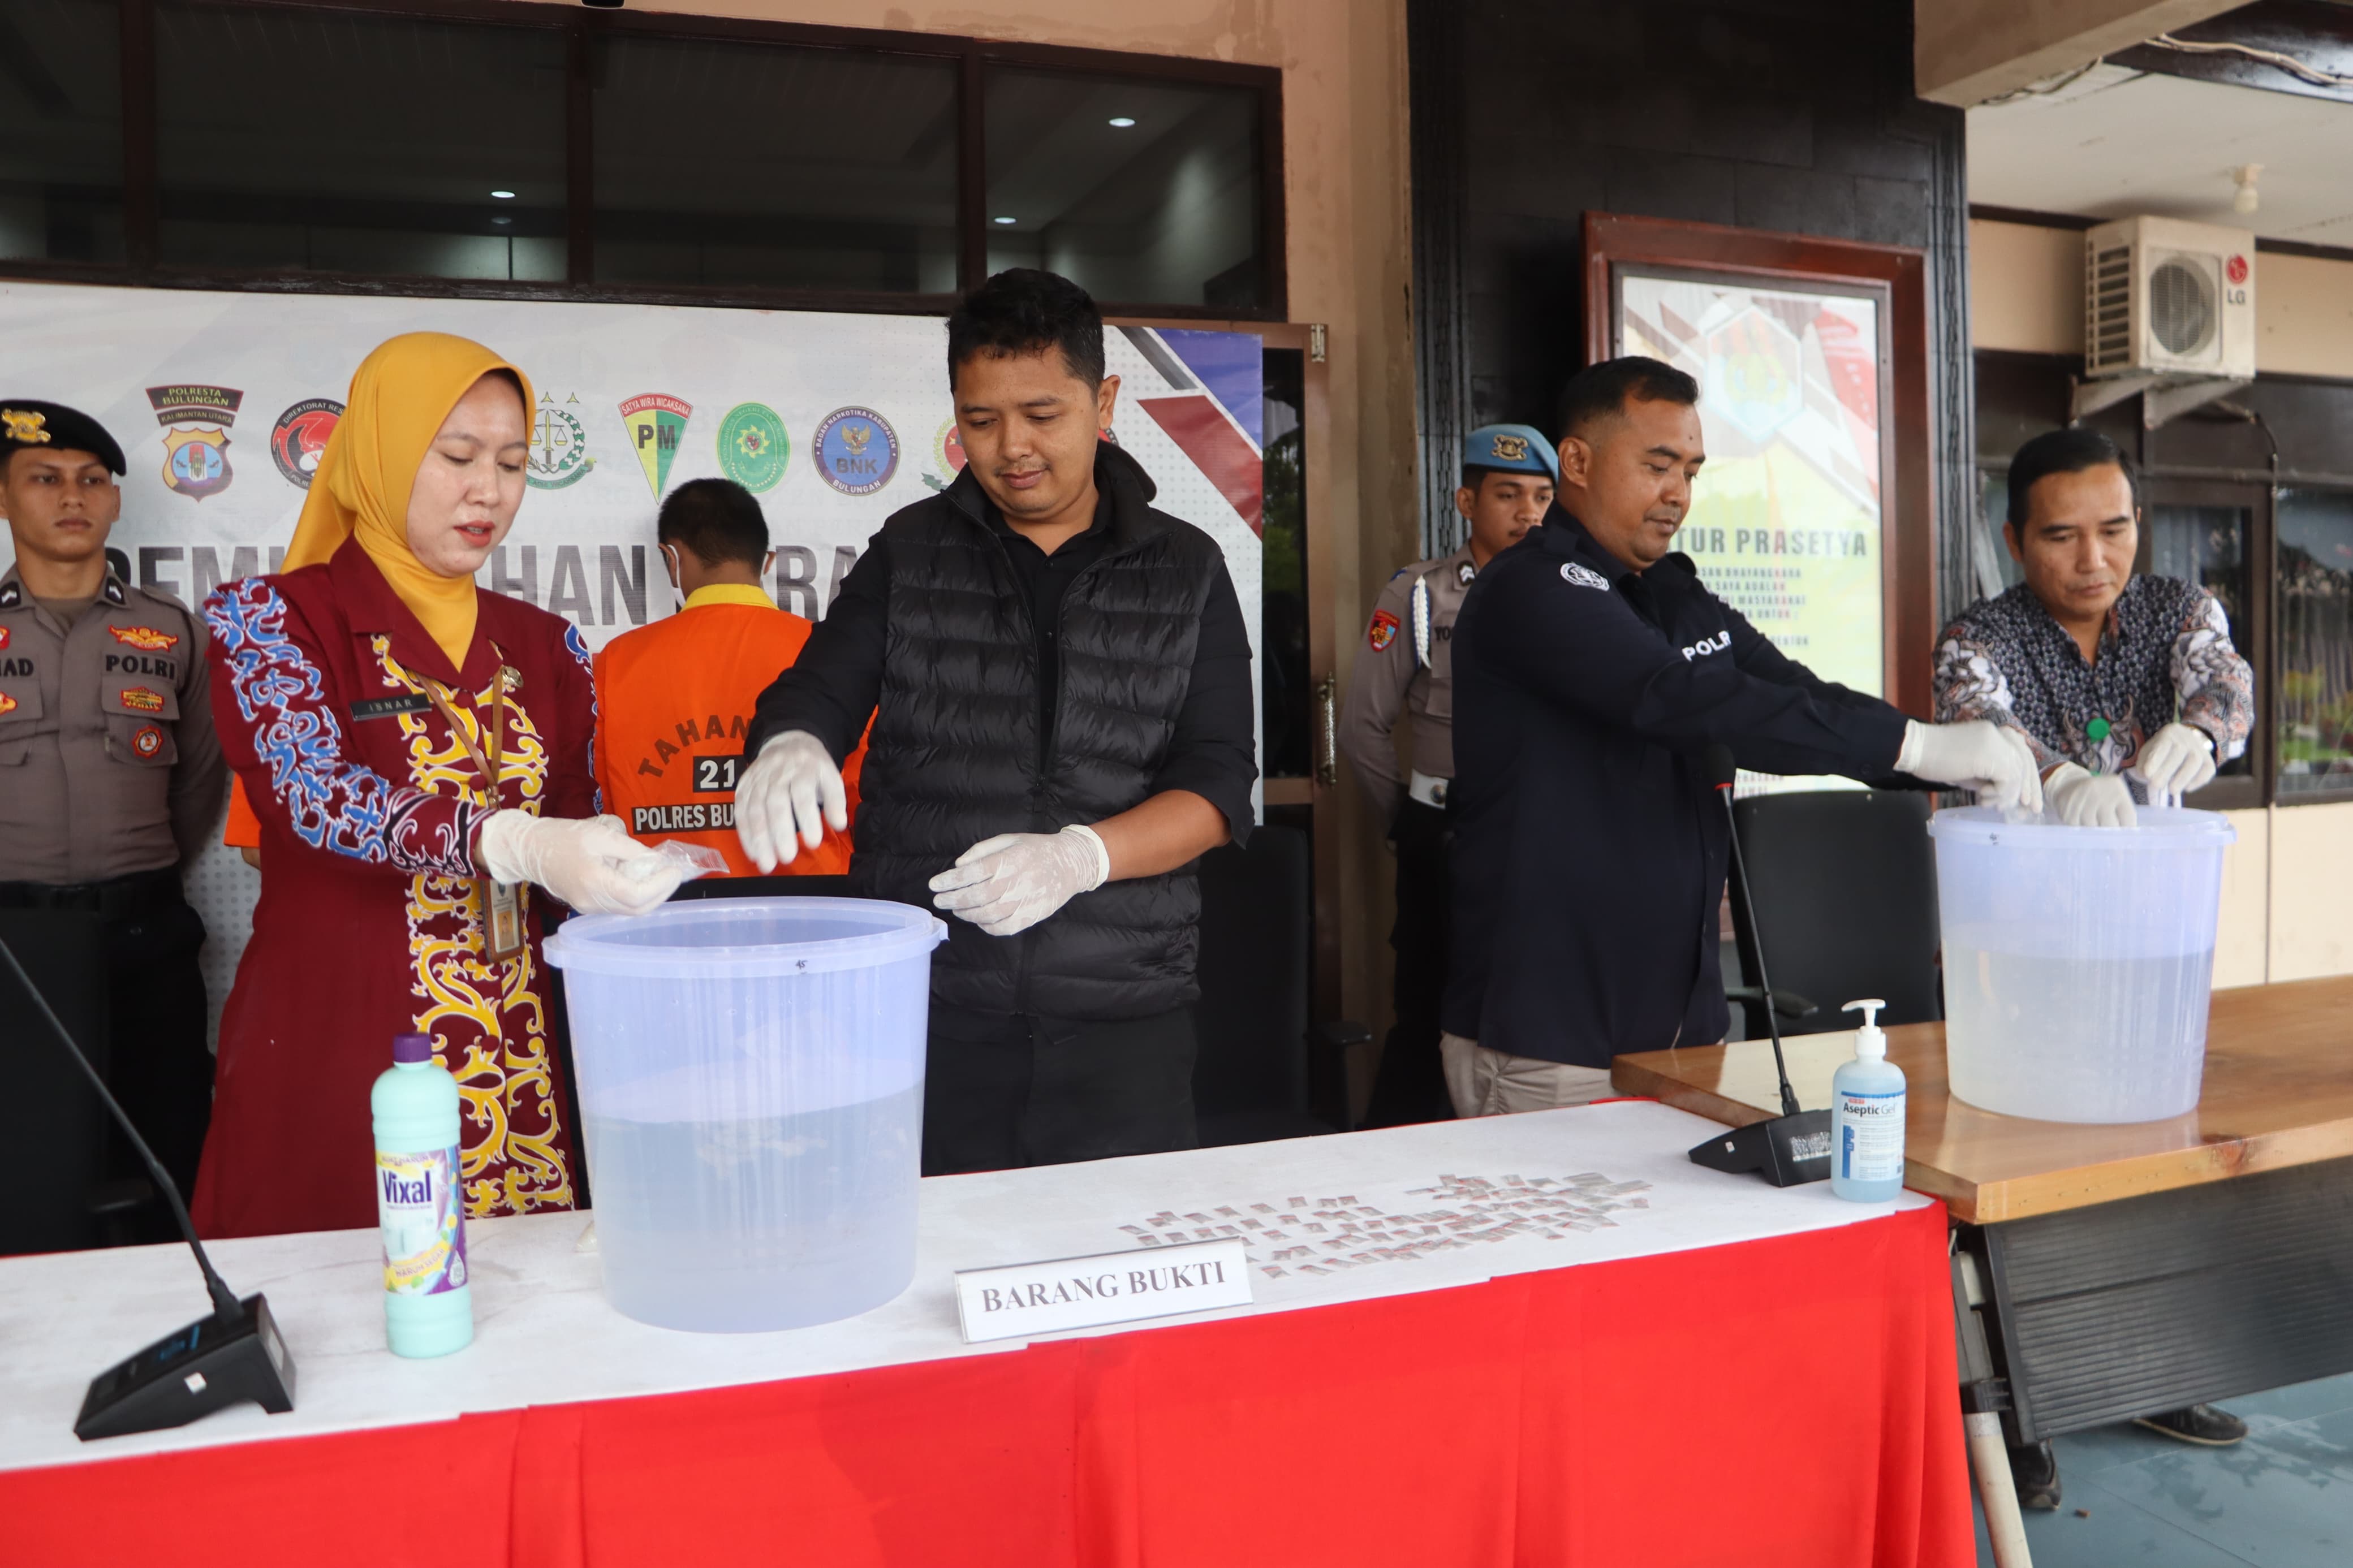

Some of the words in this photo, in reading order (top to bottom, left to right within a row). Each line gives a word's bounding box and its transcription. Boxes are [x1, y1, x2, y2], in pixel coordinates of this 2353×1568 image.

[2227, 289, 2246, 304] LG
[162, 396, 229, 406] BULUNGAN
[169, 387, 221, 396] POLRESTA
[161, 411, 207, 422] KALIMANTAN
[209, 413, 232, 423] UTARA
[283, 402, 326, 424] DIREKTORAT
[622, 399, 640, 414] SATYA
[640, 397, 656, 408] WIRA
[656, 397, 689, 416] WICAKSANA
[638, 425, 675, 449] PM
[816, 425, 829, 448] BADAN
[828, 409, 867, 425] NARKOTIKA
[868, 413, 897, 449] KABUPATEN
[836, 458, 878, 474] BNK
[833, 479, 881, 494] BULUNGAN
[1736, 529, 1867, 556] PRASETYA
[0, 657, 34, 677] AD
[105, 654, 175, 680] POLRI
[700, 759, 735, 789] 21
[635, 805, 705, 831] POLRES
[1843, 1102, 1880, 1117] Aseptic
[1881, 1103, 1895, 1114] Gel
[382, 1170, 432, 1203] Vixal
[982, 1273, 1119, 1312] BARANG
[1127, 1260, 1226, 1294] BUKTI
